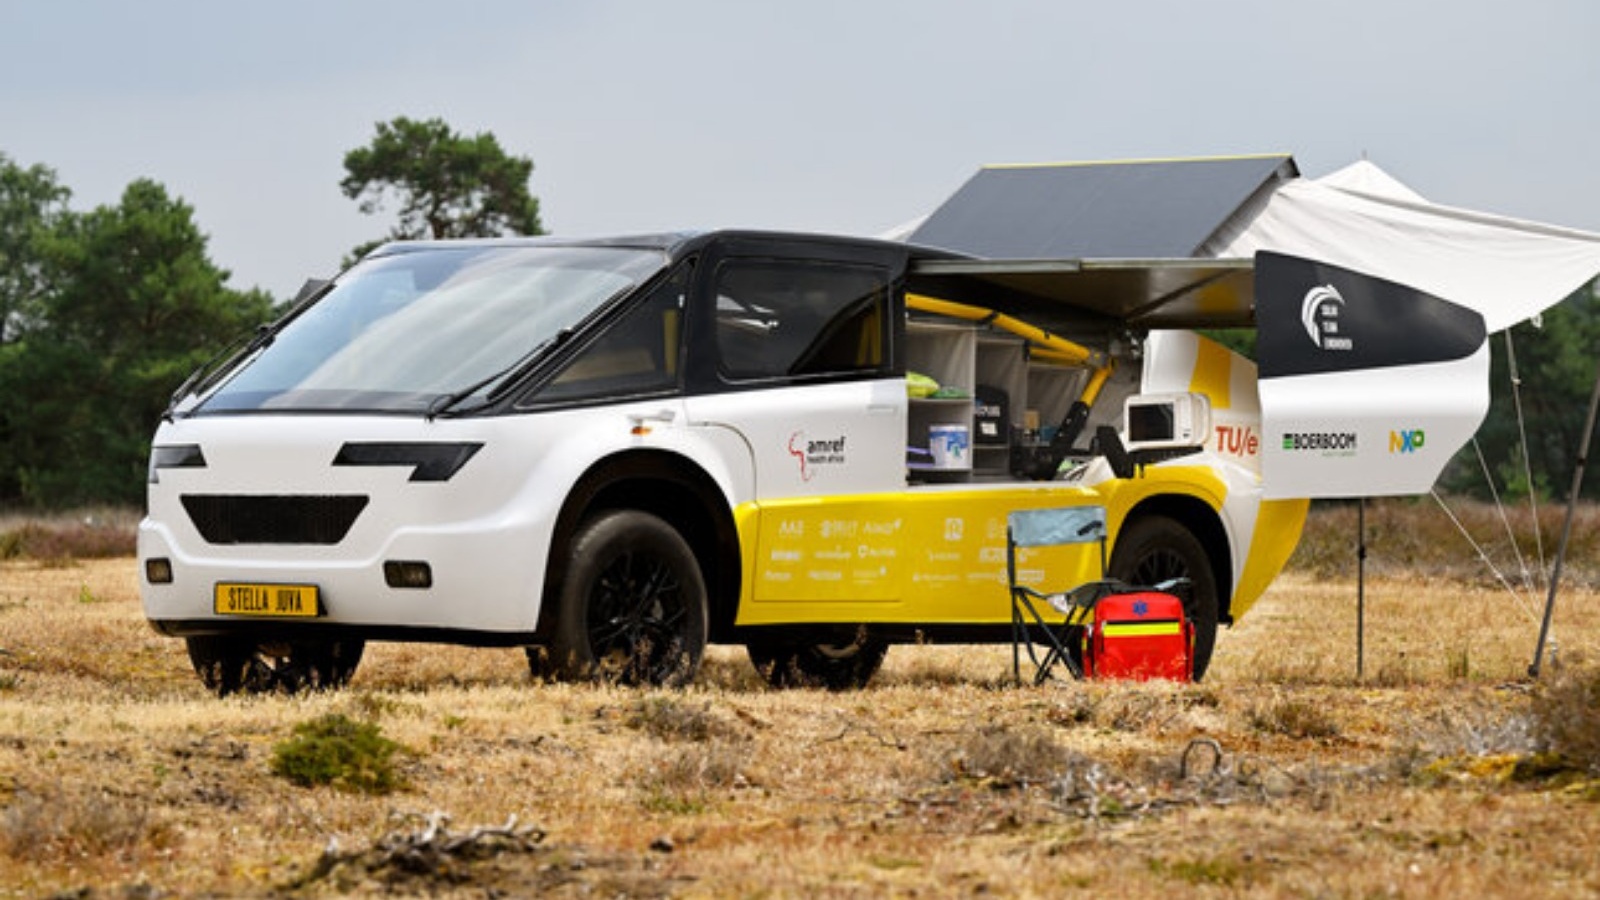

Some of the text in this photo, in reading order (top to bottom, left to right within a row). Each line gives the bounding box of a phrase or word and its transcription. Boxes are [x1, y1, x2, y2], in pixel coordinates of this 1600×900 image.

[808, 436, 846, 454] amref
[1215, 425, 1258, 456] TU/e
[1293, 433, 1357, 450] BOERBOOM
[1388, 428, 1425, 453] NXP
[228, 586, 303, 612] STELLA JUVA
